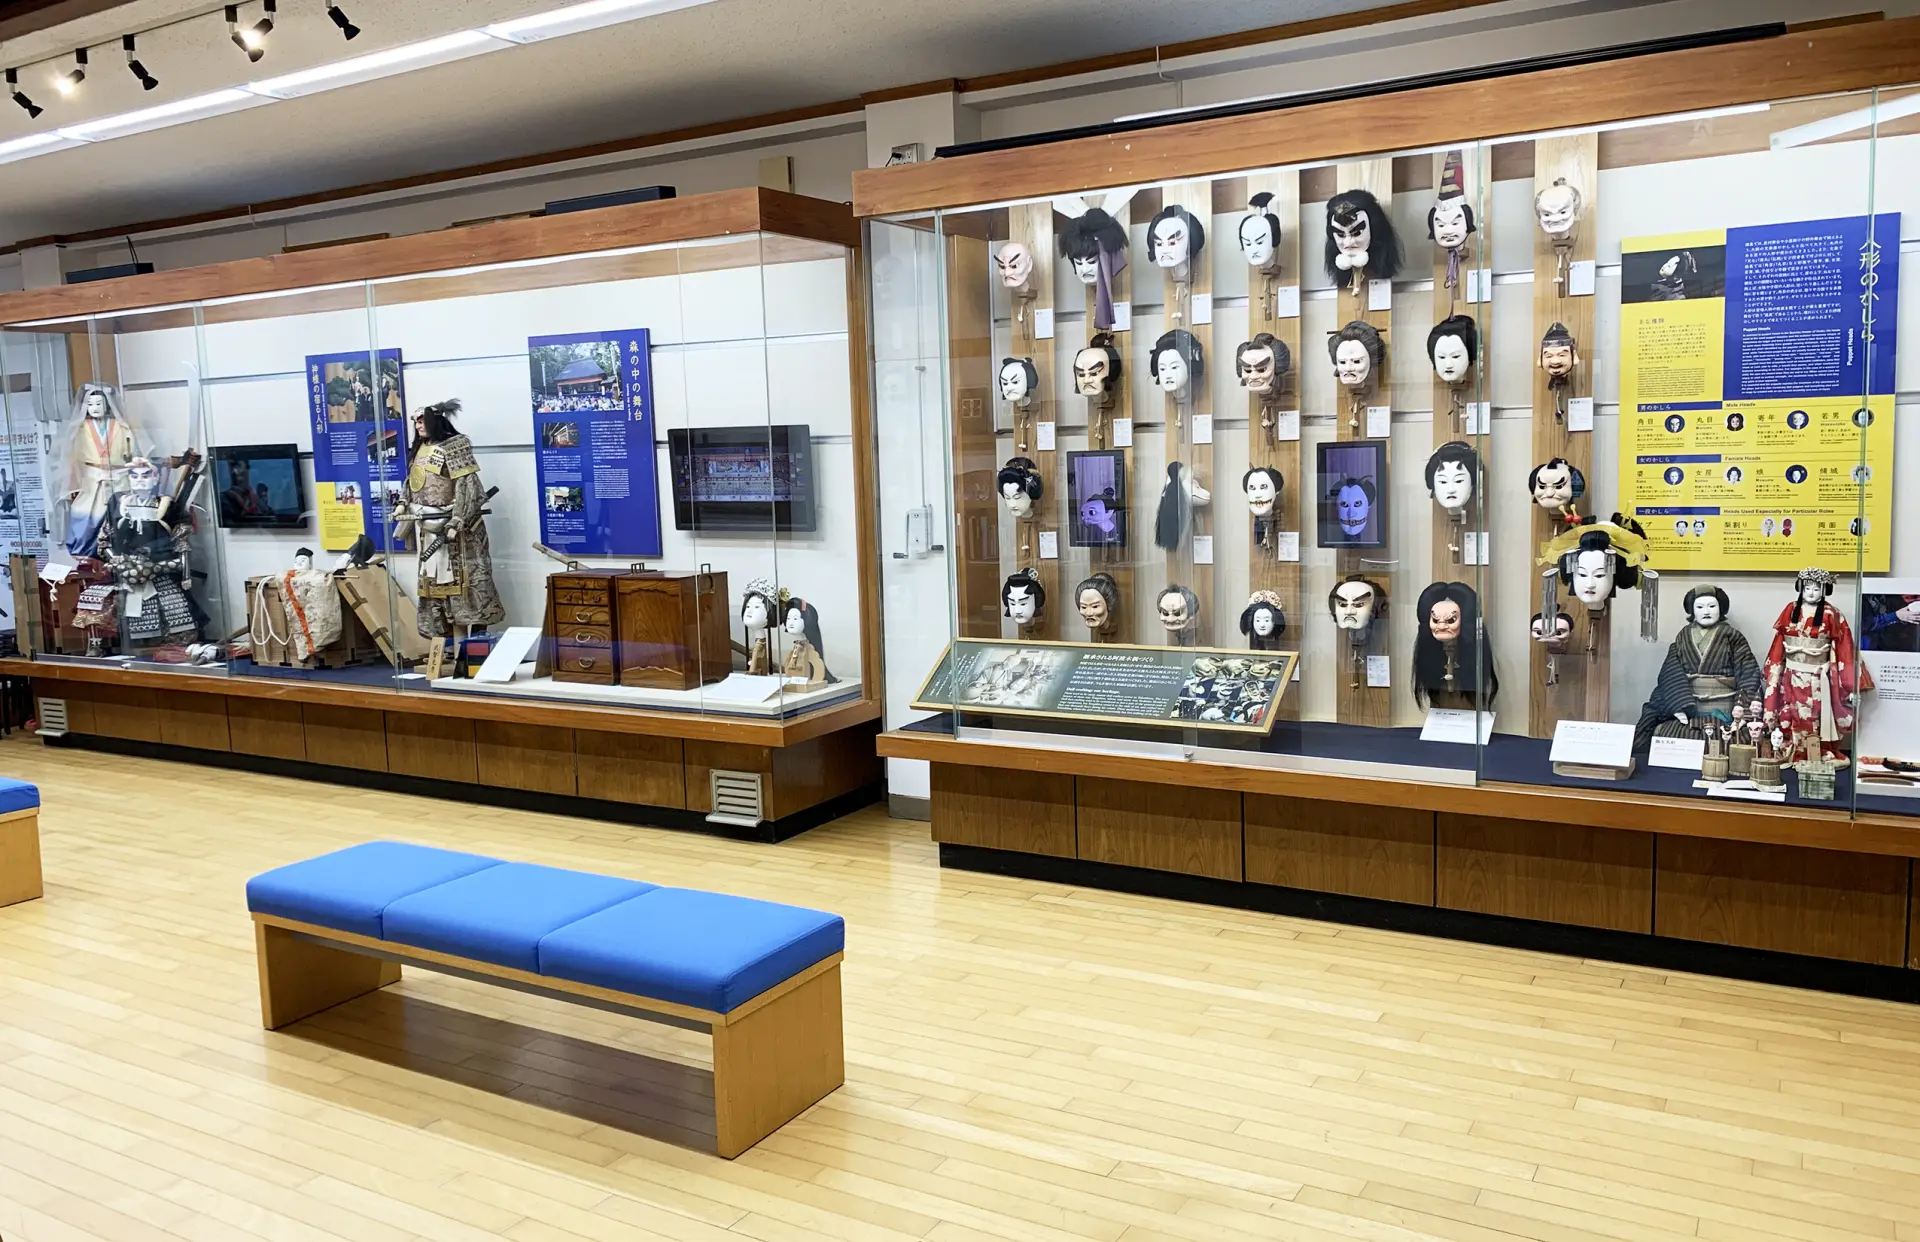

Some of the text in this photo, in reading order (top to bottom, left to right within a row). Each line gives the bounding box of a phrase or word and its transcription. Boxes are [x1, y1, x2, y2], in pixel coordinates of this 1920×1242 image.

[1859, 241, 1882, 341] 人形のかしら
[629, 340, 642, 421] 森の中の舞台
